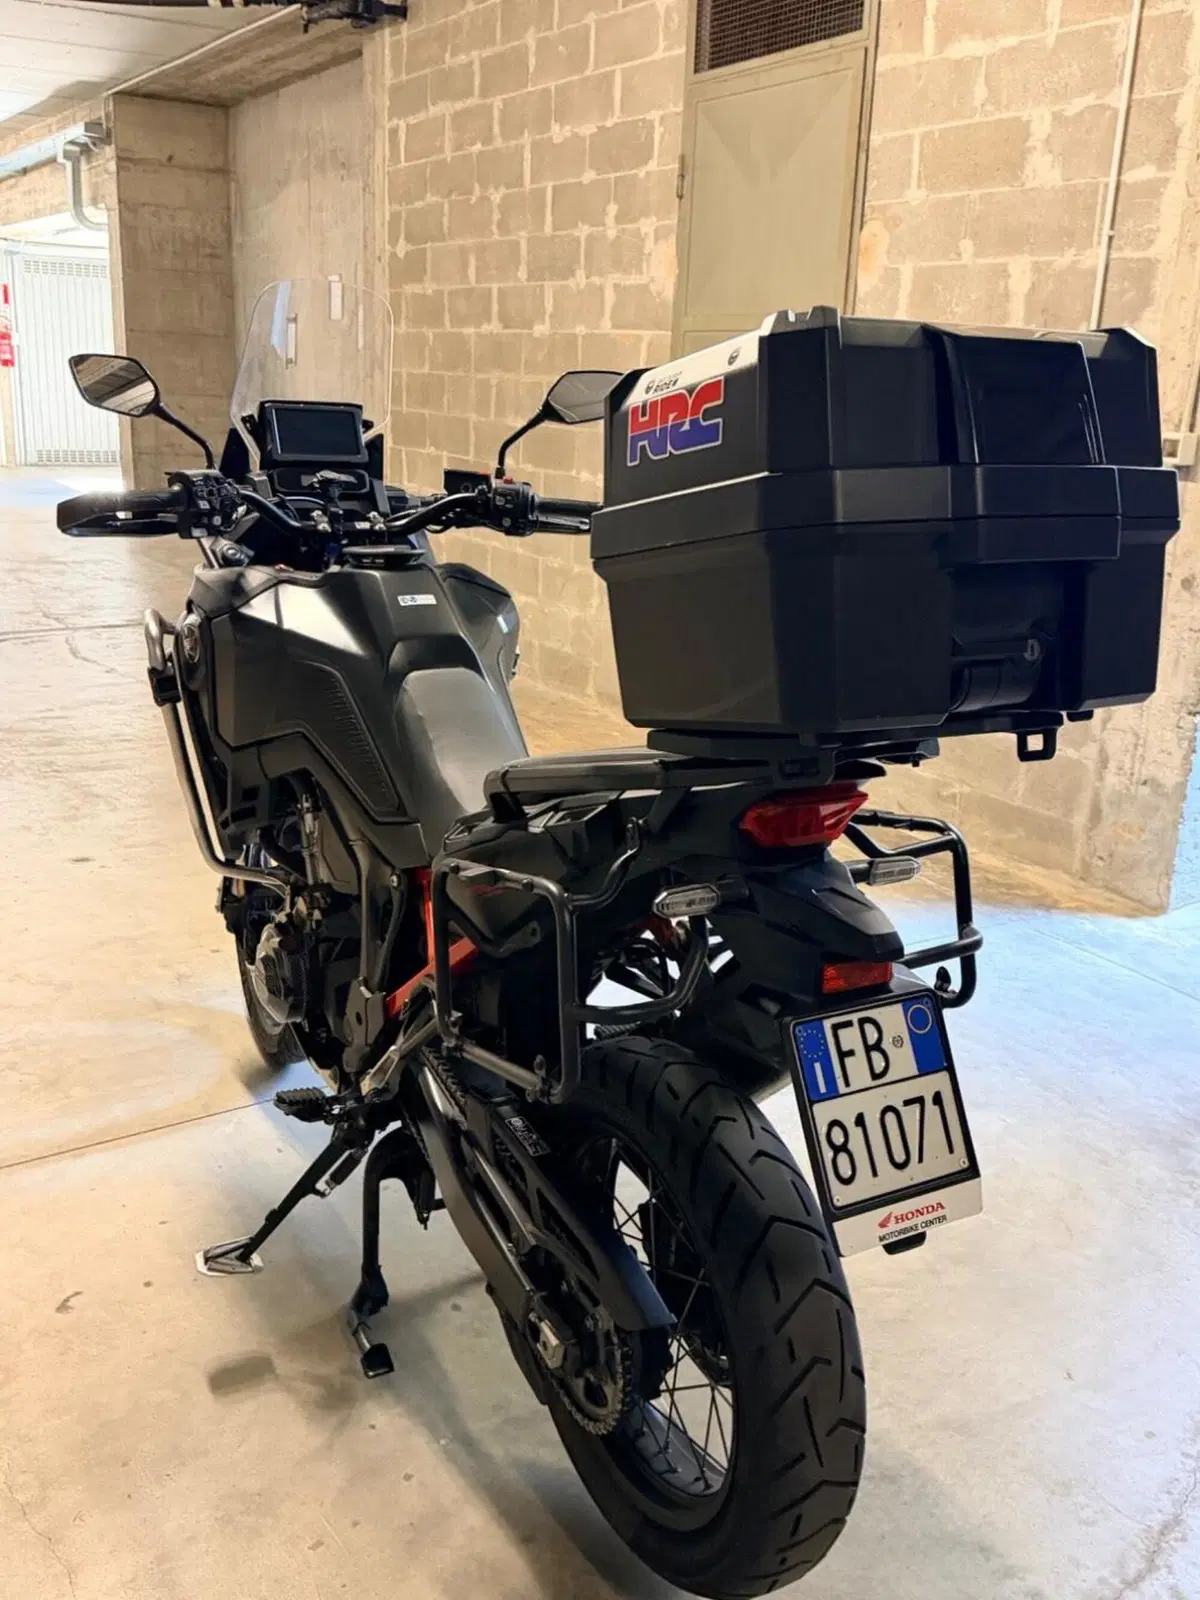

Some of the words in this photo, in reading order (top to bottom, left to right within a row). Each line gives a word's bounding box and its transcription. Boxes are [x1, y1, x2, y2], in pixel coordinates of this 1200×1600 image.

[627, 376, 725, 467] HRC
[831, 1016, 890, 1088] FB
[825, 1090, 955, 1186] 81071
[878, 1223, 920, 1243] MOTORBIKE
[920, 1214, 948, 1230] CENTER
[894, 1202, 946, 1225] HONDA
